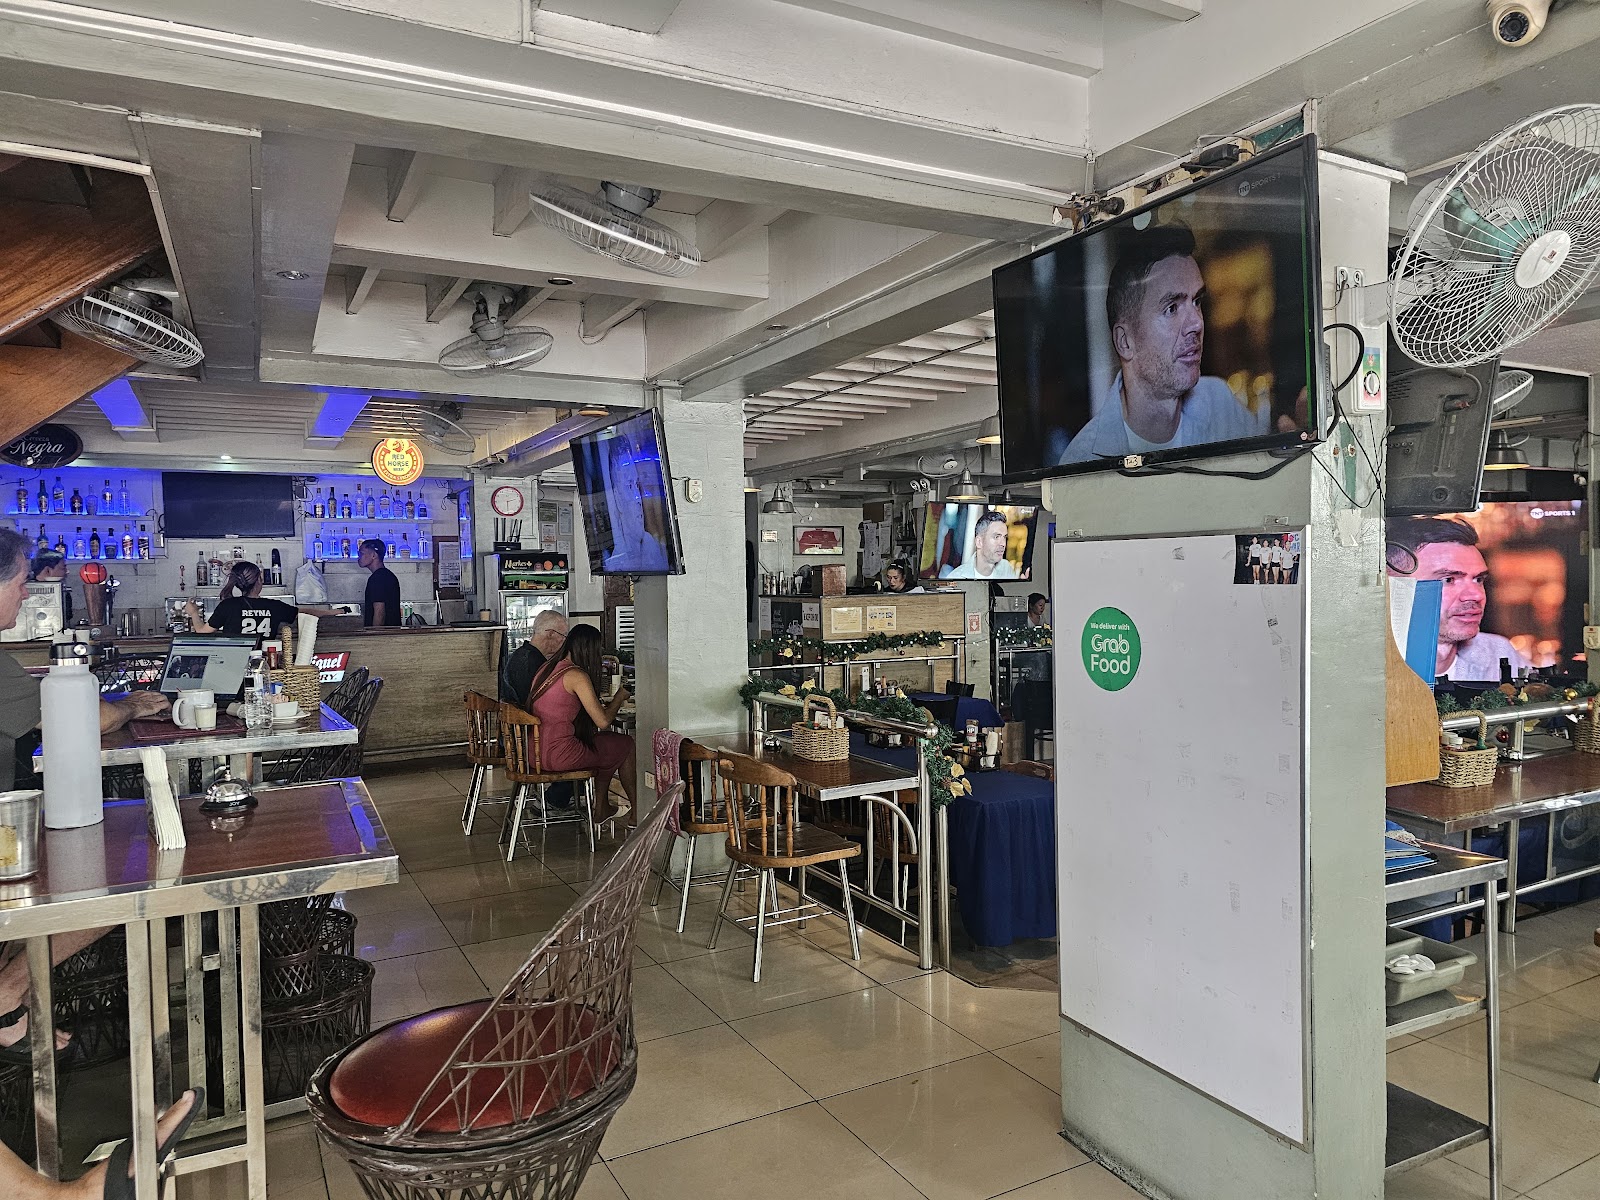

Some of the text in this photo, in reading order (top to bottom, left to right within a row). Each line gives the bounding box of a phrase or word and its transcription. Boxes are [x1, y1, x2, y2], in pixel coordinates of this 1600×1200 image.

[1239, 183, 1251, 195] TNT
[1251, 176, 1275, 188] SPORTS
[10, 441, 65, 458] Negra
[241, 618, 271, 637] 24
[1092, 634, 1130, 654] Grab
[312, 653, 344, 670] iguel
[1091, 654, 1130, 675] Food
